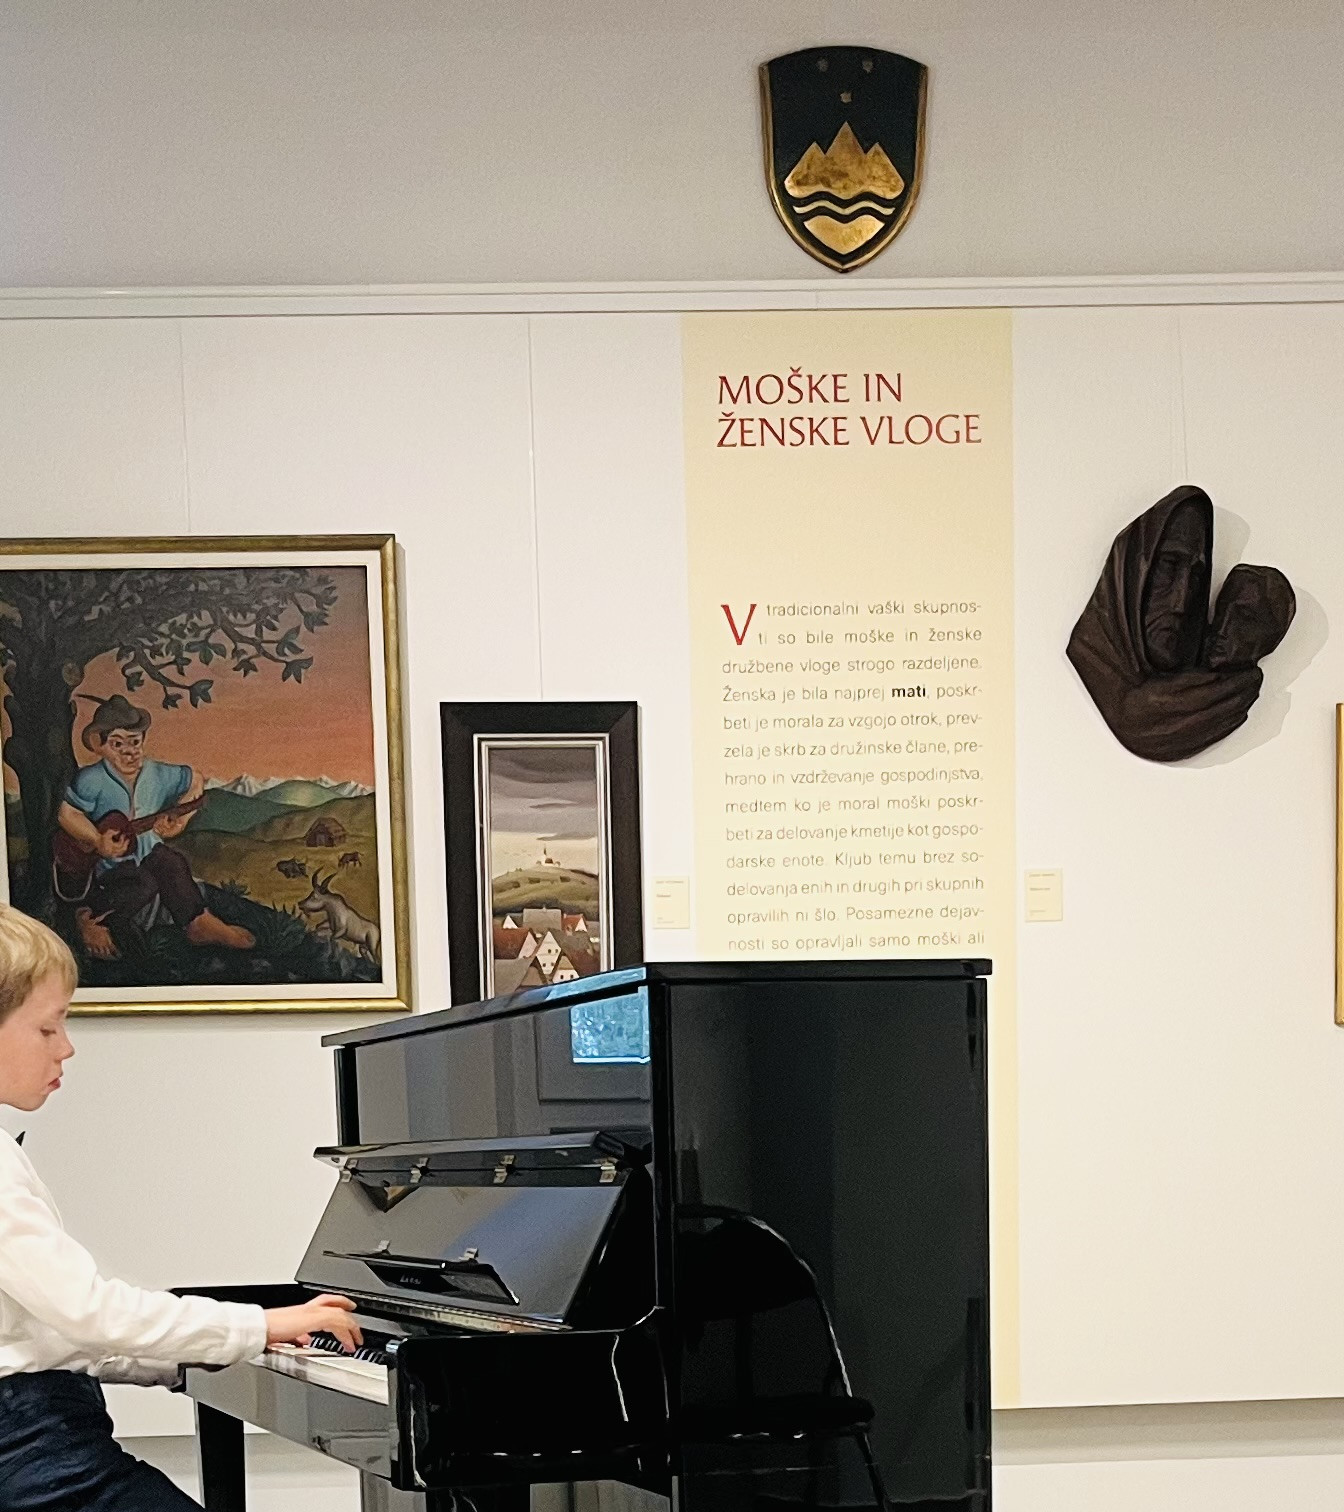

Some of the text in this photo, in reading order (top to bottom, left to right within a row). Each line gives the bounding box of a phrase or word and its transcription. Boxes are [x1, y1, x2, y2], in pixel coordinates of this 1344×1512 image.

[718, 366, 902, 405] MOŠKE IN
[717, 412, 982, 447] ŽENSKE VLOGE
[721, 601, 981, 645] V tradicionalni vaški skupnos-
[759, 627, 982, 644] ti so bile moške in ženske
[723, 660, 793, 674] družbene
[800, 659, 840, 675] vloge
[848, 659, 895, 673] strogo
[723, 683, 983, 703] Ženska je bila najprej mati, poskr-
[724, 714, 983, 731] beti je morala za vzgojo otrok, prev-
[724, 740, 983, 759] zela je skrb za družinske člane, pre-
[725, 772, 766, 785] hrano
[773, 771, 784, 784] in
[792, 770, 874, 785] vzdrževanje
[726, 794, 983, 813] medtem ko je moral moški poskr-
[727, 823, 983, 841] beti za delovanje kmetije kot gospo-
[727, 855, 775, 868] darske
[836, 852, 871, 867] Kljub
[879, 852, 916, 864] temu
[924, 850, 954, 863] brez
[962, 851, 984, 862] so-
[727, 878, 984, 897] delovanja enih in drugih pri skupnih
[728, 905, 984, 925] opravilih ni šlo. Posamezne dejav-
[729, 931, 984, 951] nosti so opravljali samo moški ali
